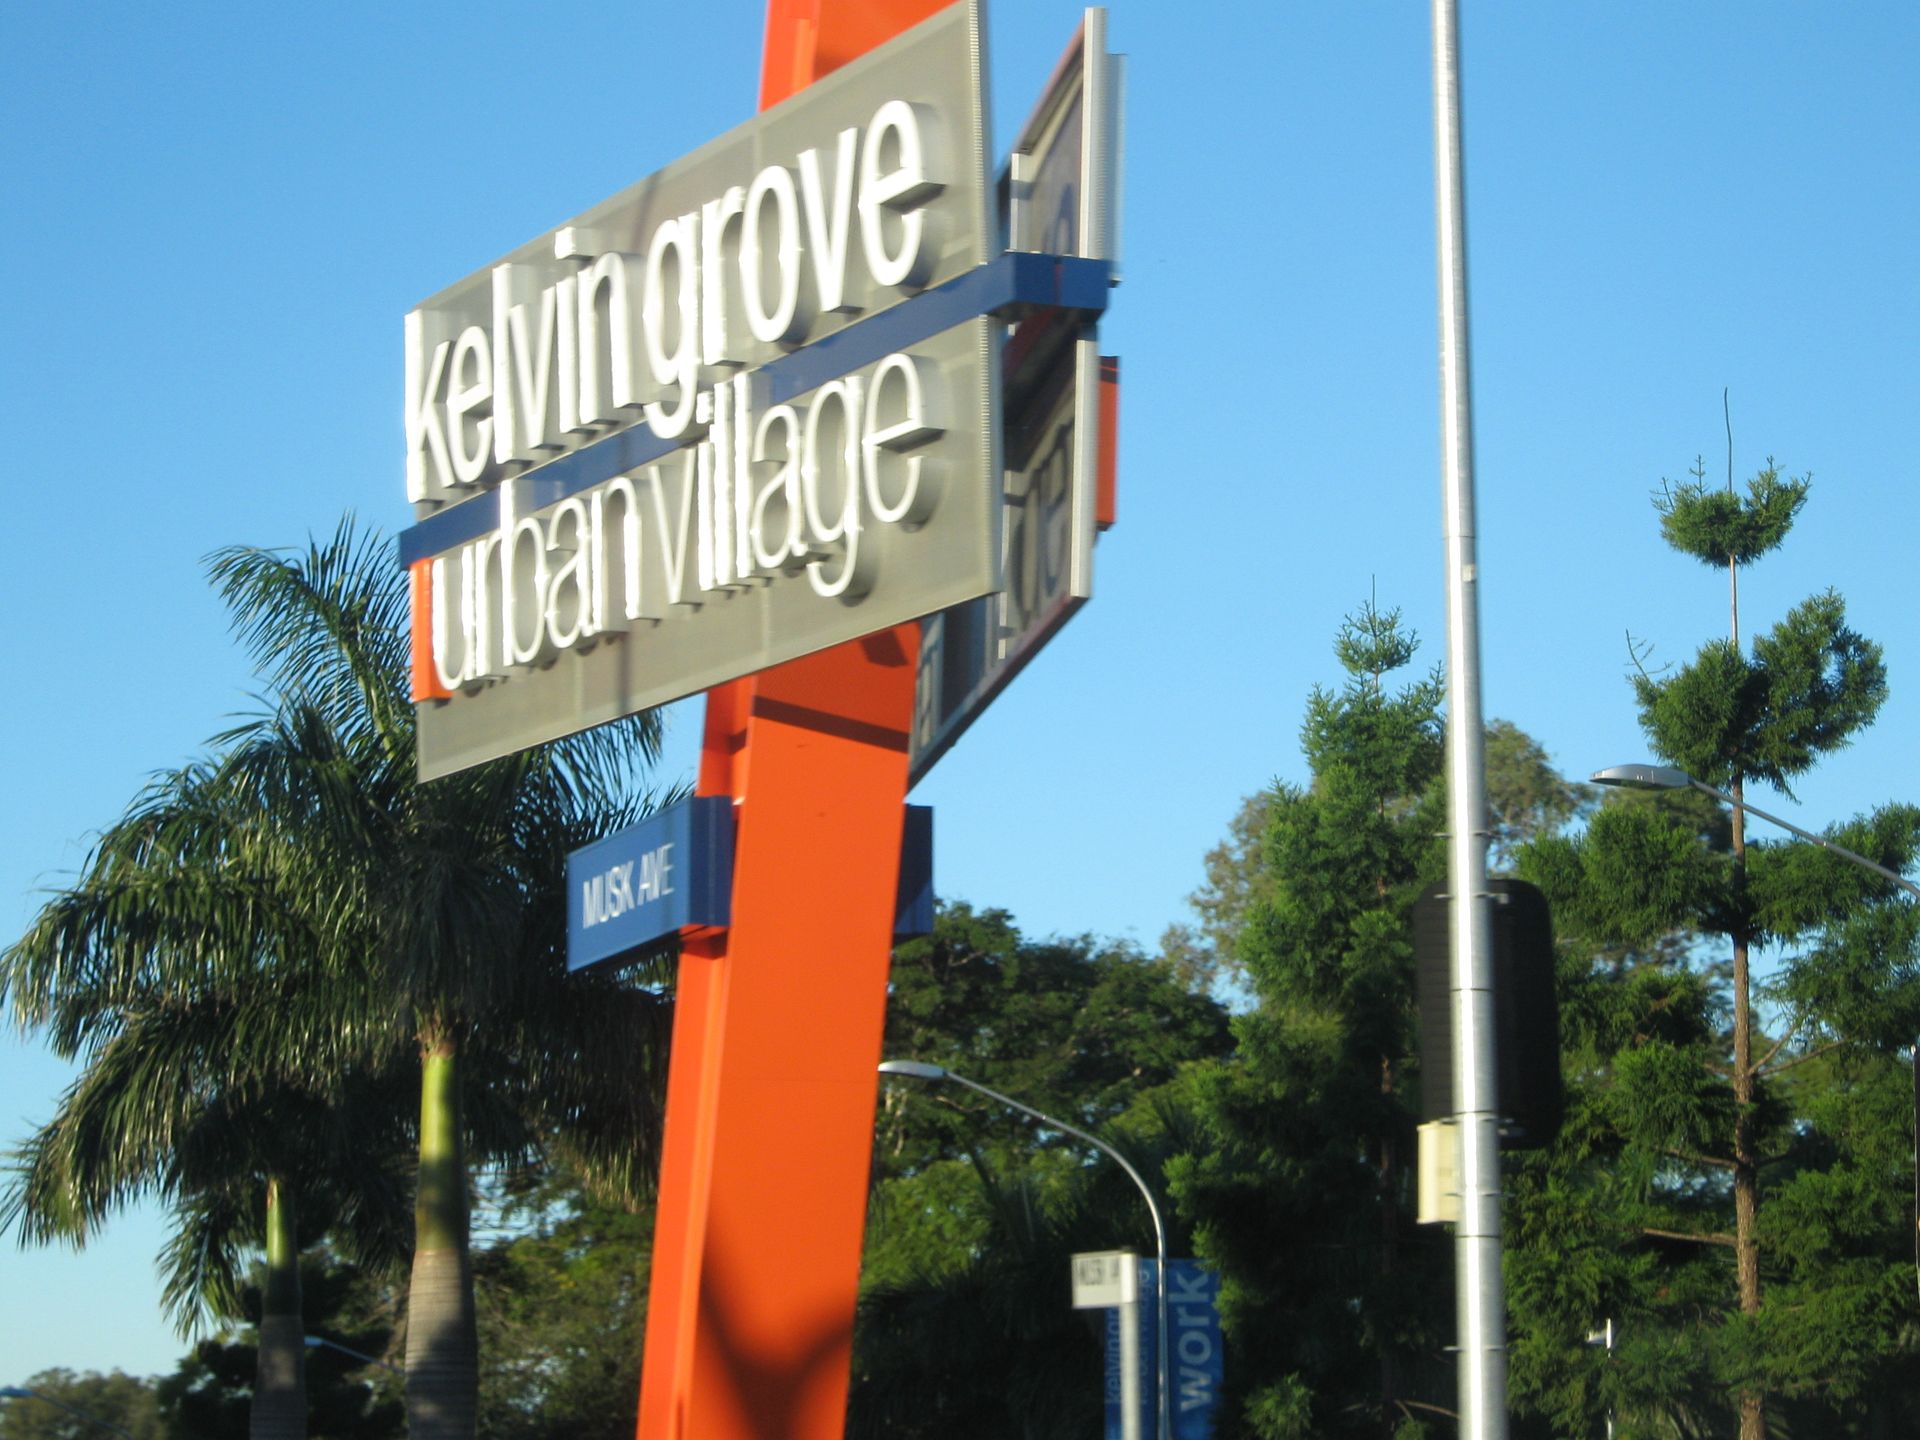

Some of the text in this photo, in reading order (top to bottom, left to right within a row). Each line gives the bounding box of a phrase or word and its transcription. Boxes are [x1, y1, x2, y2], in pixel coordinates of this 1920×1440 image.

[582, 842, 675, 929] MUSK AVE
[1168, 1270, 1213, 1412] work
